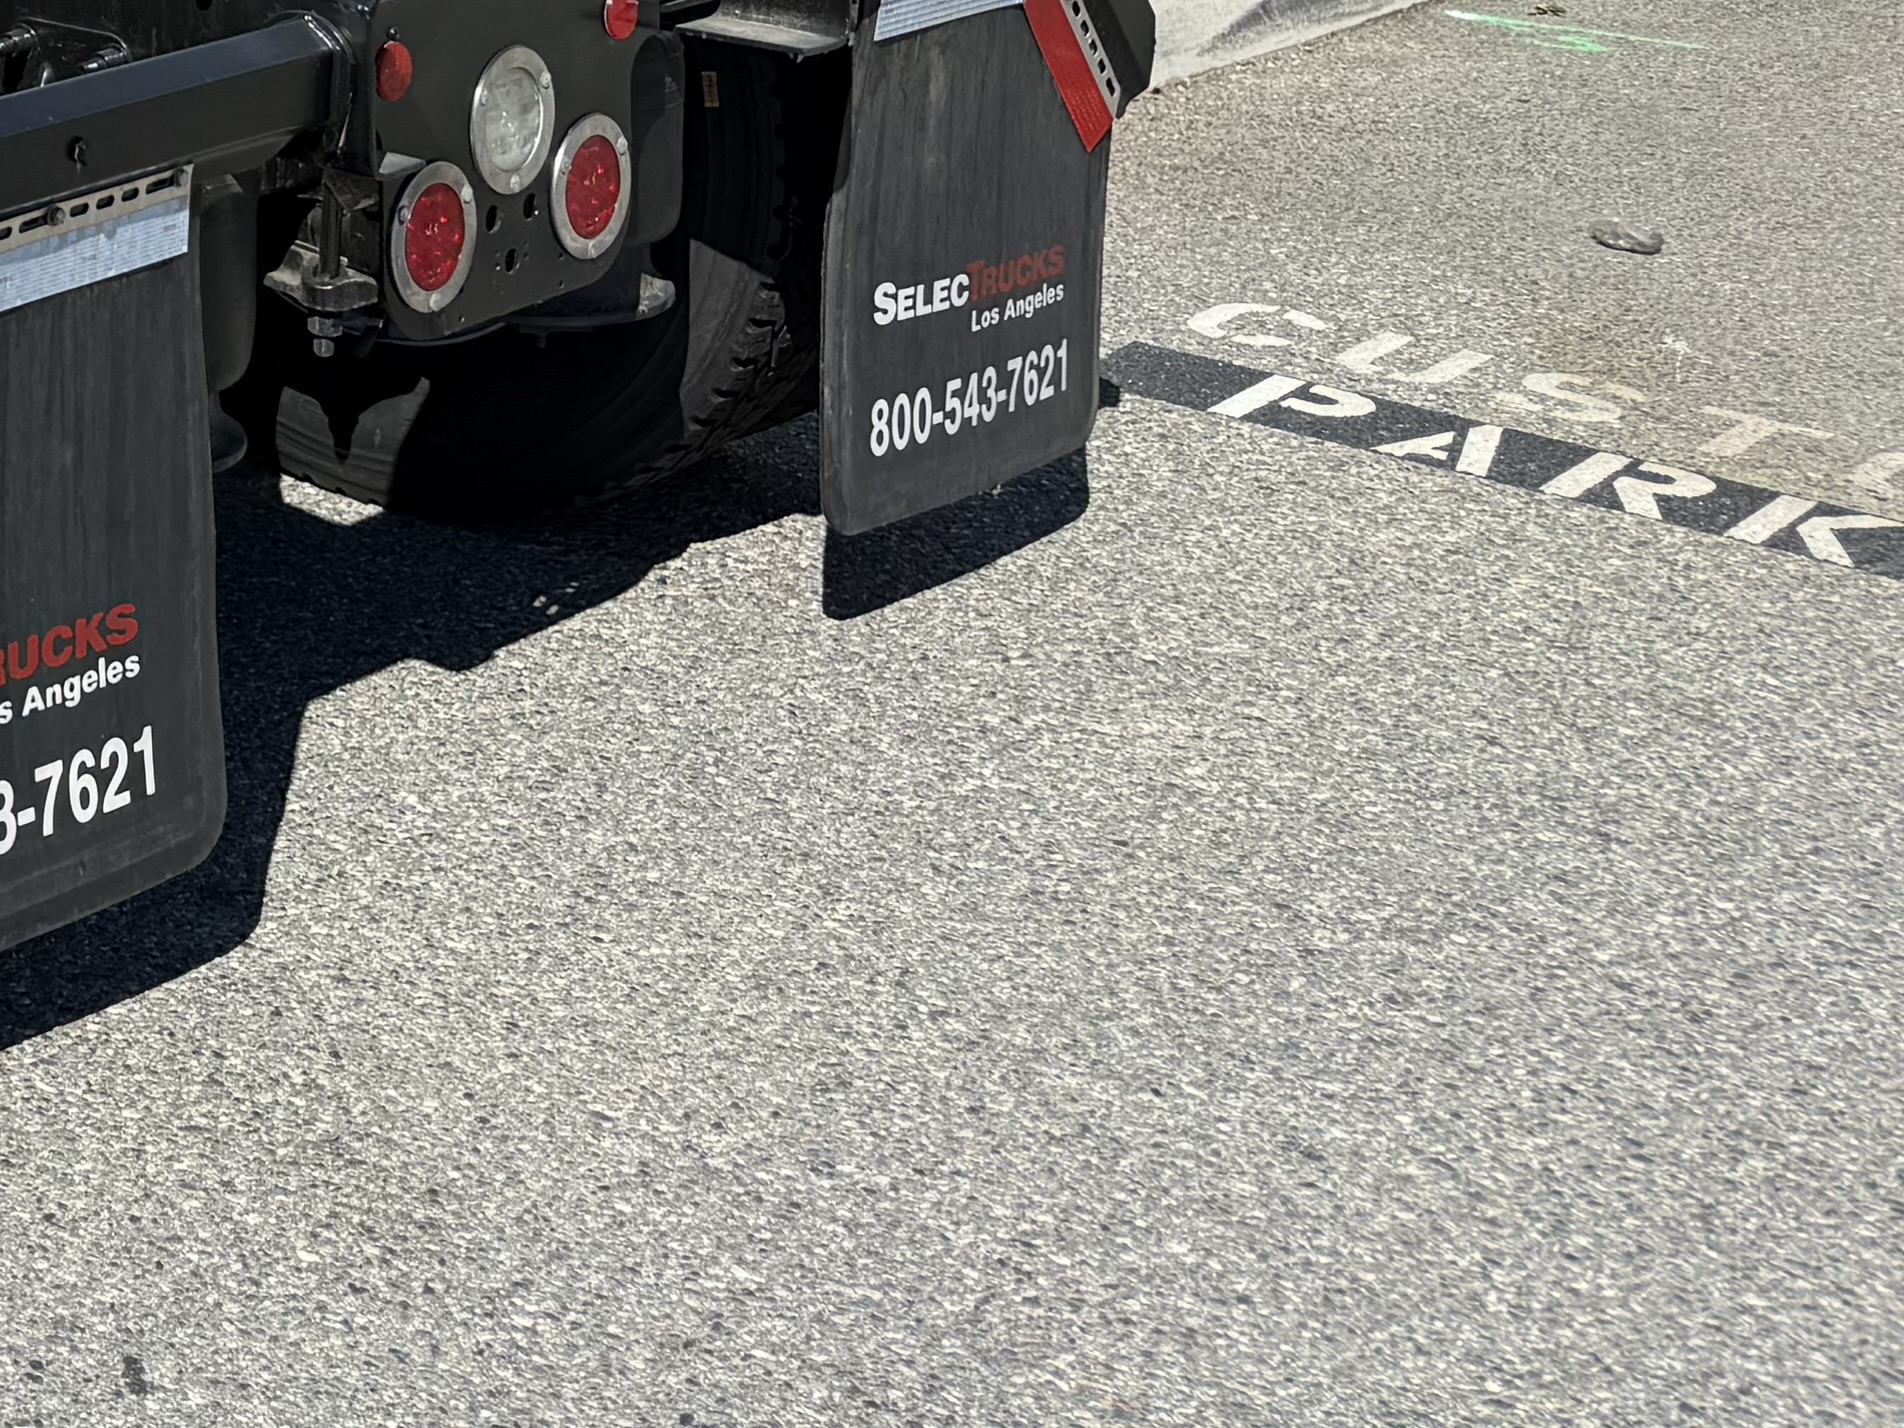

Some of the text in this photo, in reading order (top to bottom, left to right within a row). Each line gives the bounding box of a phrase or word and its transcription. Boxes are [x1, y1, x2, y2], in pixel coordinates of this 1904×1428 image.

[971, 282, 1064, 332] Los Angeles
[870, 338, 1068, 457] 800-543-7621
[1207, 374, 1904, 567] PARK
[22, 654, 141, 717] Angeles
